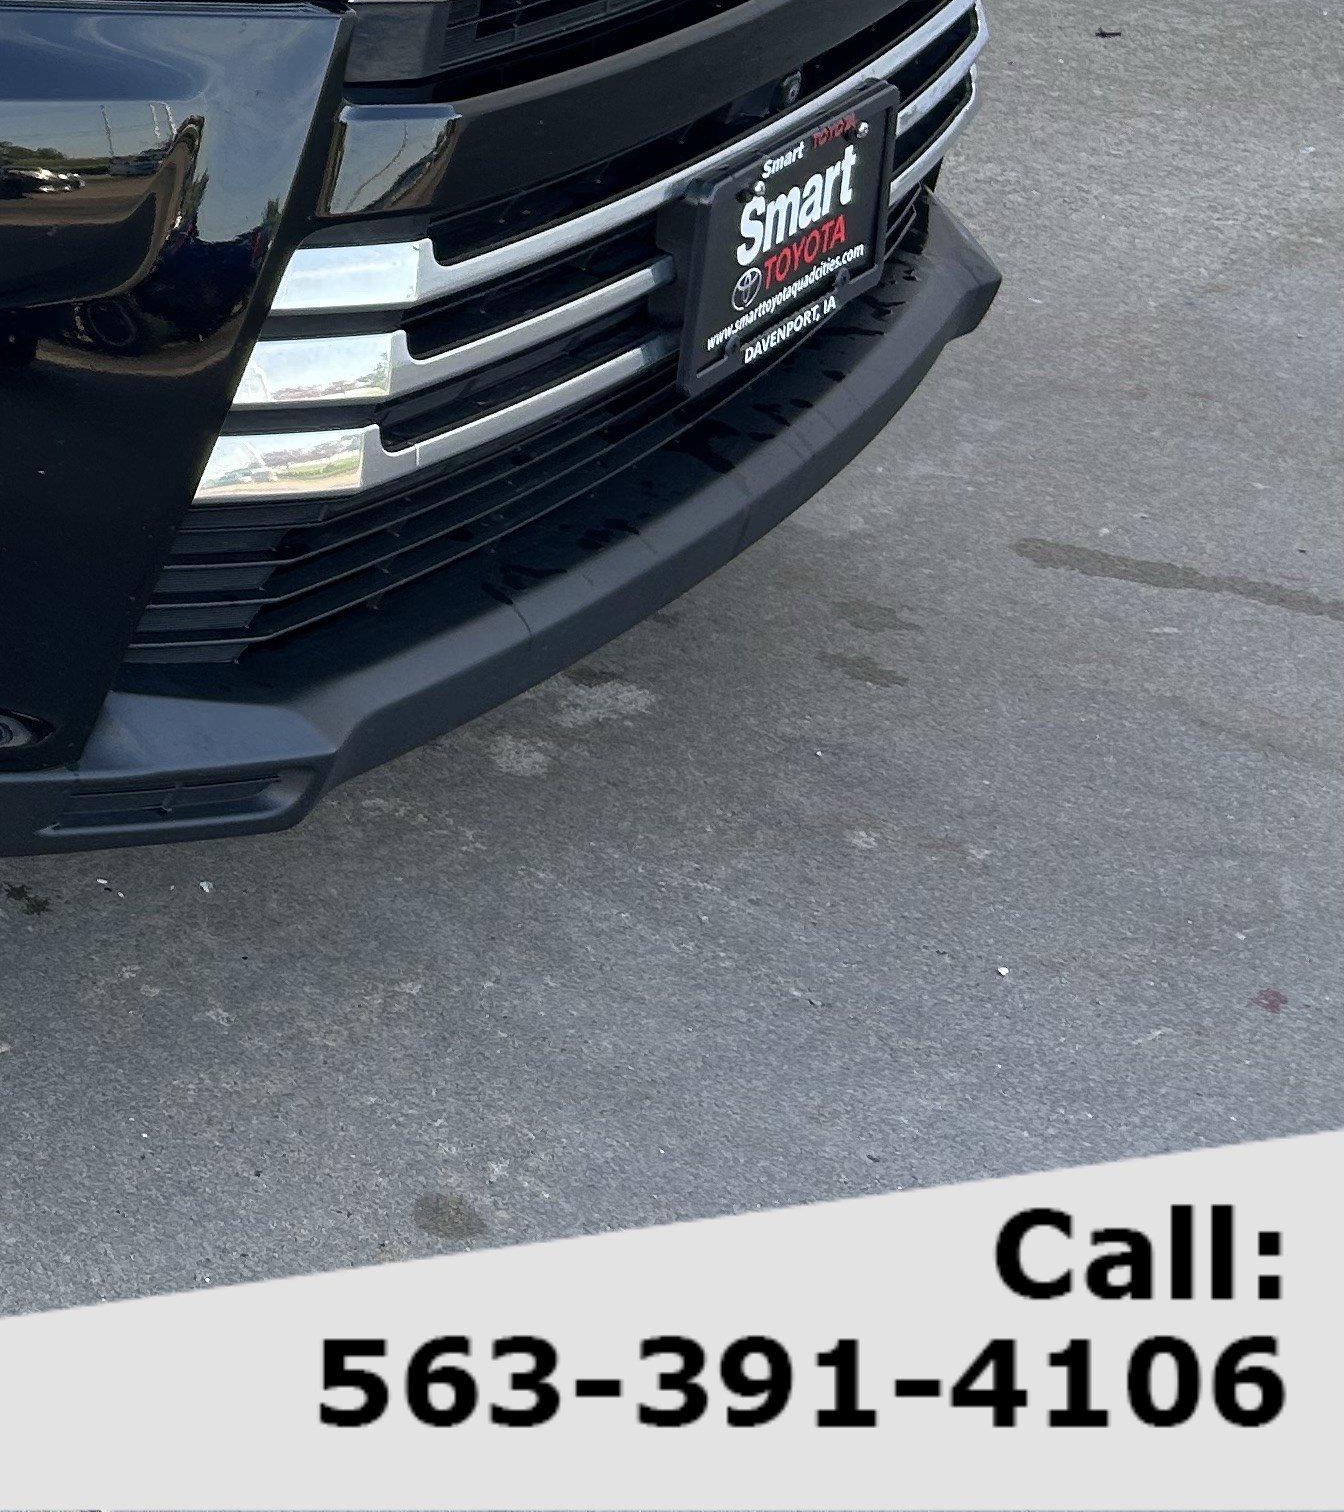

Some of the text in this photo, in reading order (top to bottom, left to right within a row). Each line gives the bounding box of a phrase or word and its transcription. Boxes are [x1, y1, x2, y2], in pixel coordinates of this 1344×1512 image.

[761, 140, 805, 179] Smart
[736, 144, 857, 266] Smart
[763, 214, 847, 290] TOYOTA
[706, 243, 865, 351] www.smarttoyotaquadcities.com
[744, 295, 837, 364] DAVENPORT, IA
